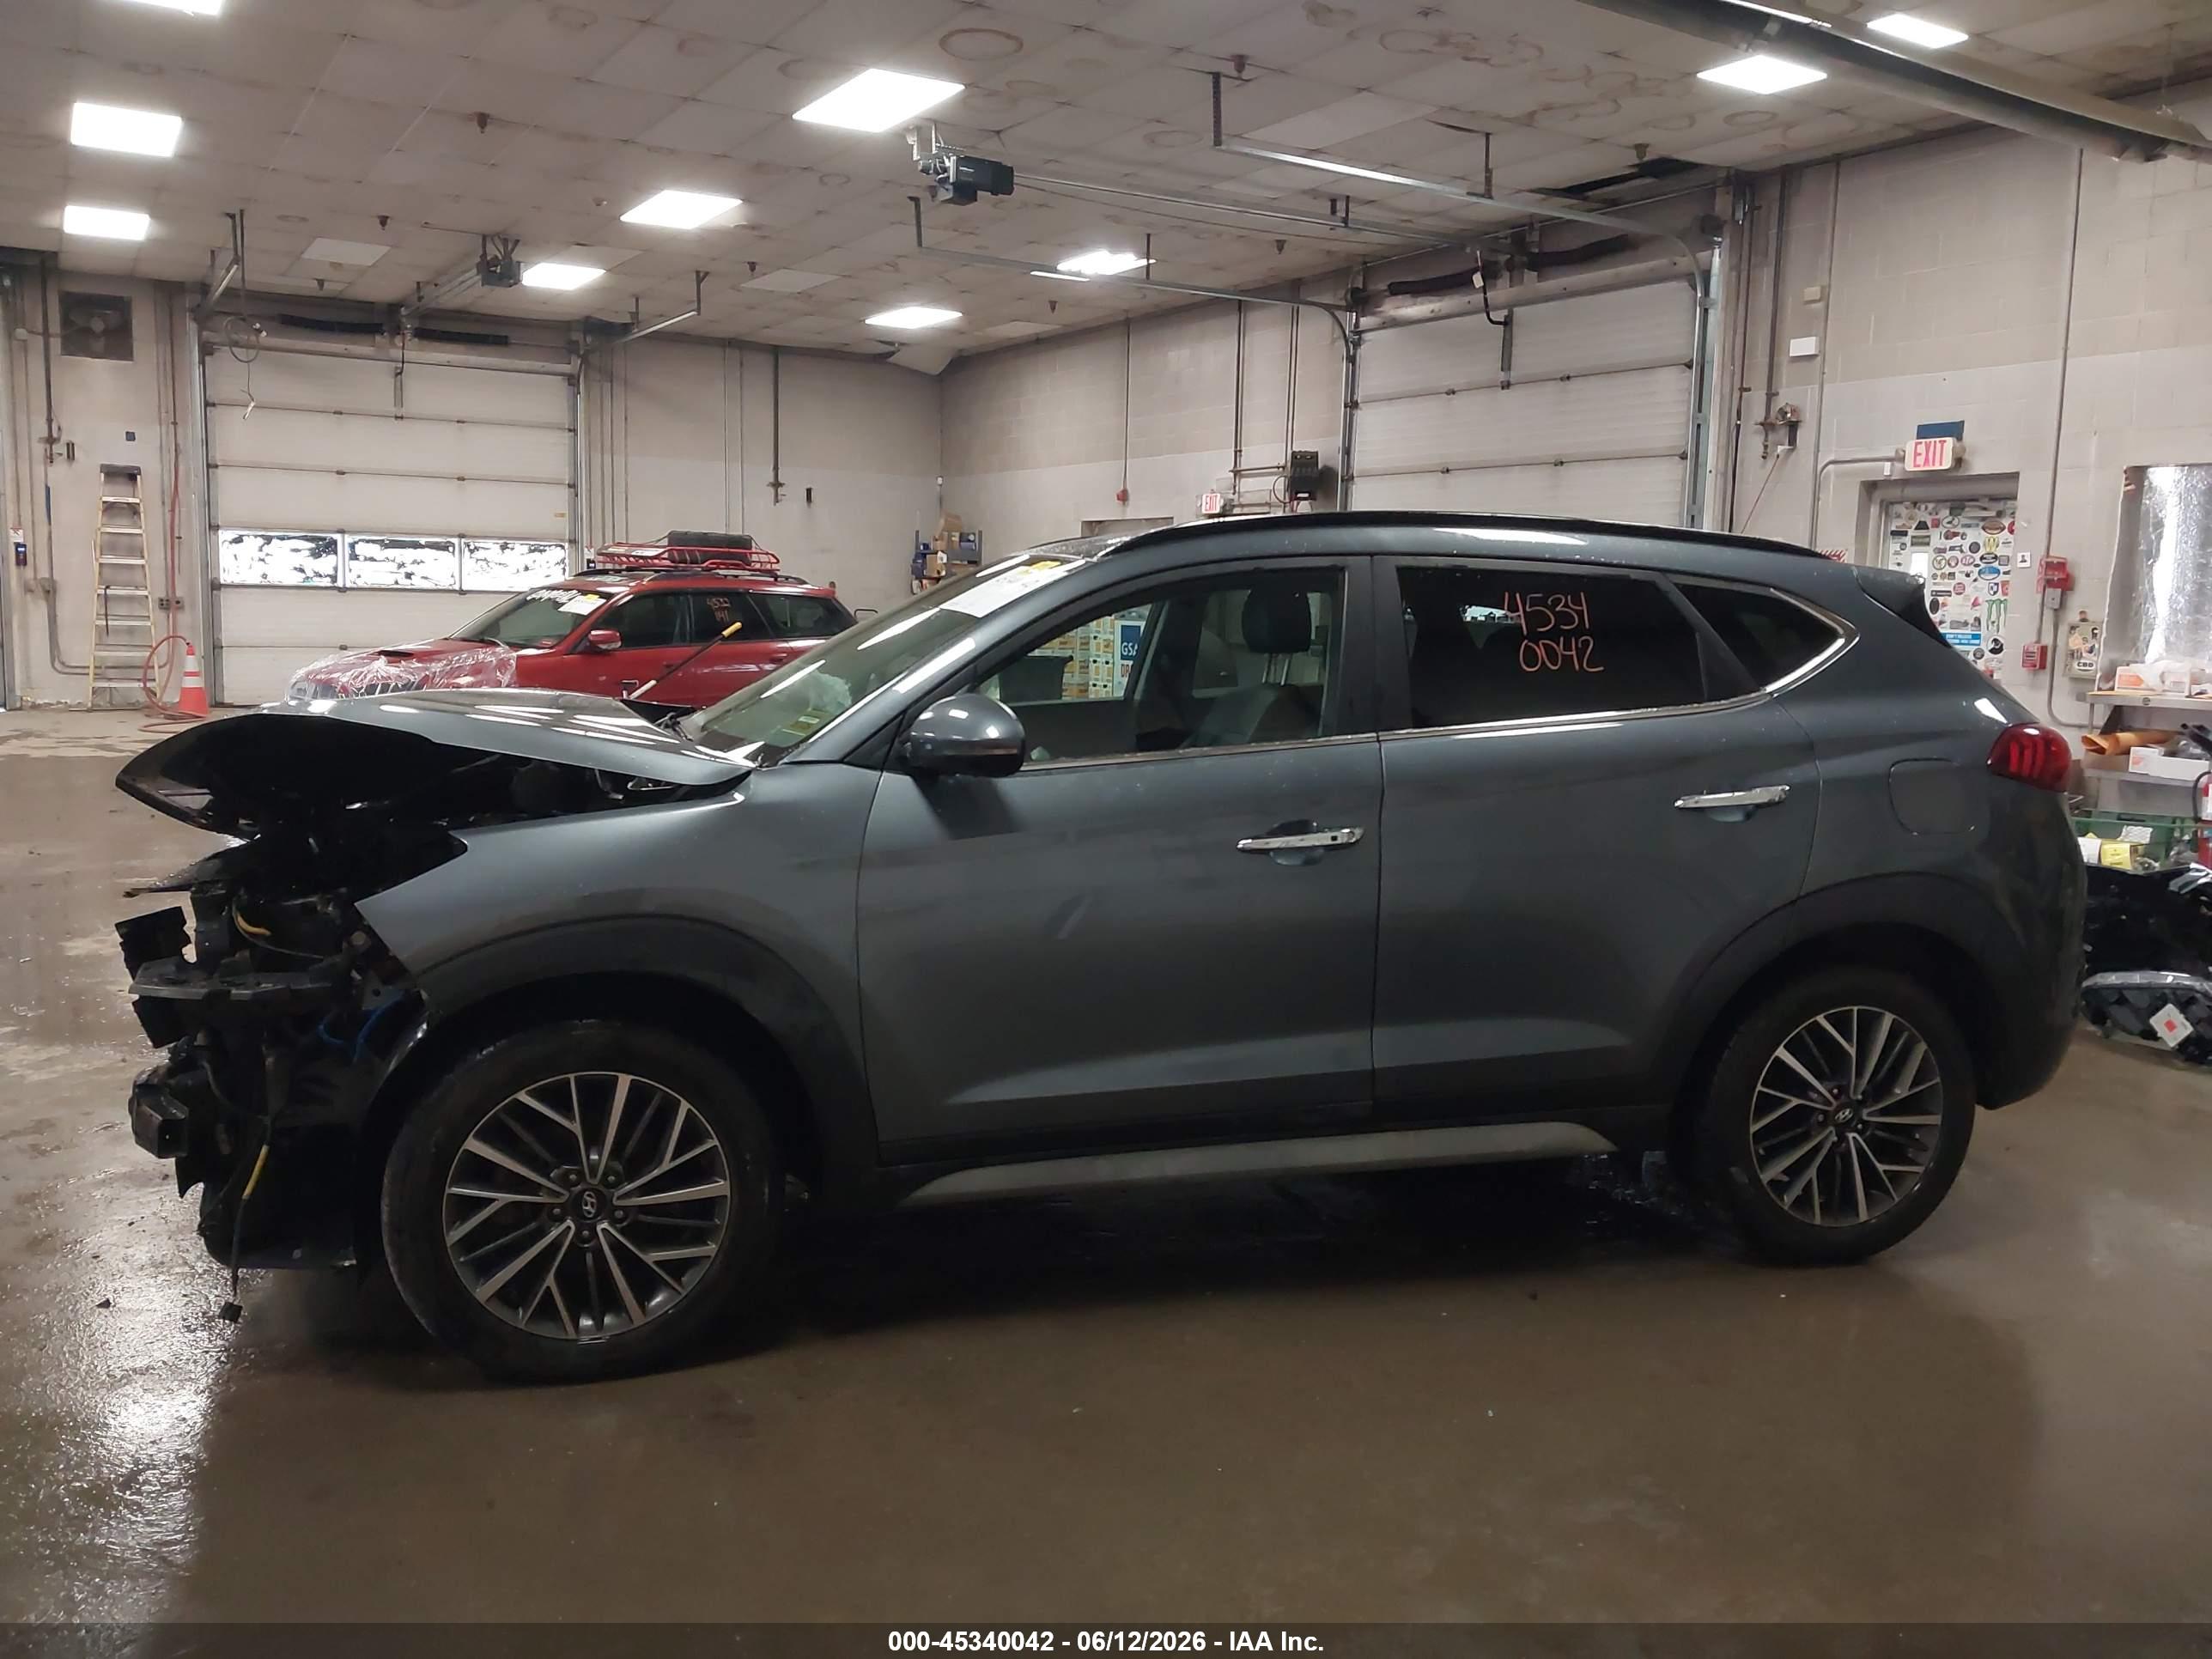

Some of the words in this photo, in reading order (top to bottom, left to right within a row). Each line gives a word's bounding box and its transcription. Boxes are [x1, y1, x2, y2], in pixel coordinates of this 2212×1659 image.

[1913, 439, 1948, 468] EXIT
[1204, 494, 1218, 512] EXIT
[1504, 591, 1589, 635] 4534
[1519, 635, 1605, 672] 0042
